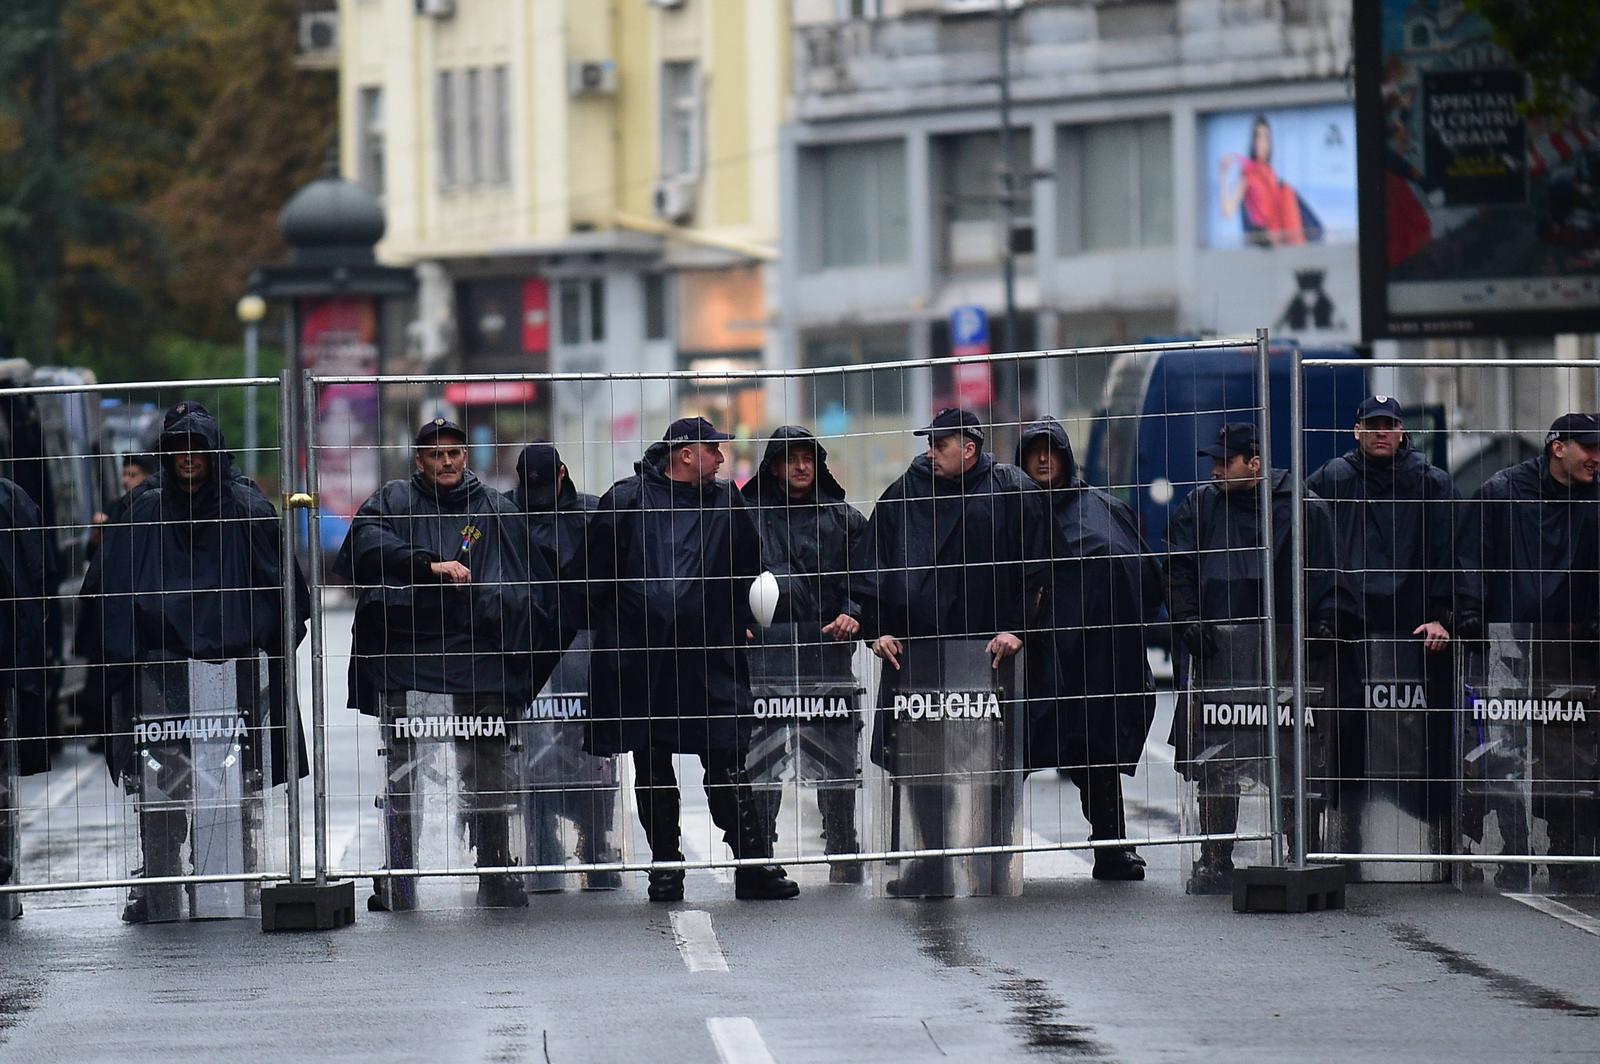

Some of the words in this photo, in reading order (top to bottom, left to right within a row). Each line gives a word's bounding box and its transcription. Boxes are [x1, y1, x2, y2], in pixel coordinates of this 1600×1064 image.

[753, 697, 849, 720] ОЛИЦИЈА
[894, 693, 1001, 720] POLICIJA
[1364, 684, 1427, 708] ICIJA
[1203, 703, 1315, 728] ПОЛИИА
[1473, 699, 1586, 725] ПОЛИЦИЈА
[134, 717, 248, 744] ПОЛИЦИЈА
[395, 716, 506, 740] ПОЛИЦИЈА
